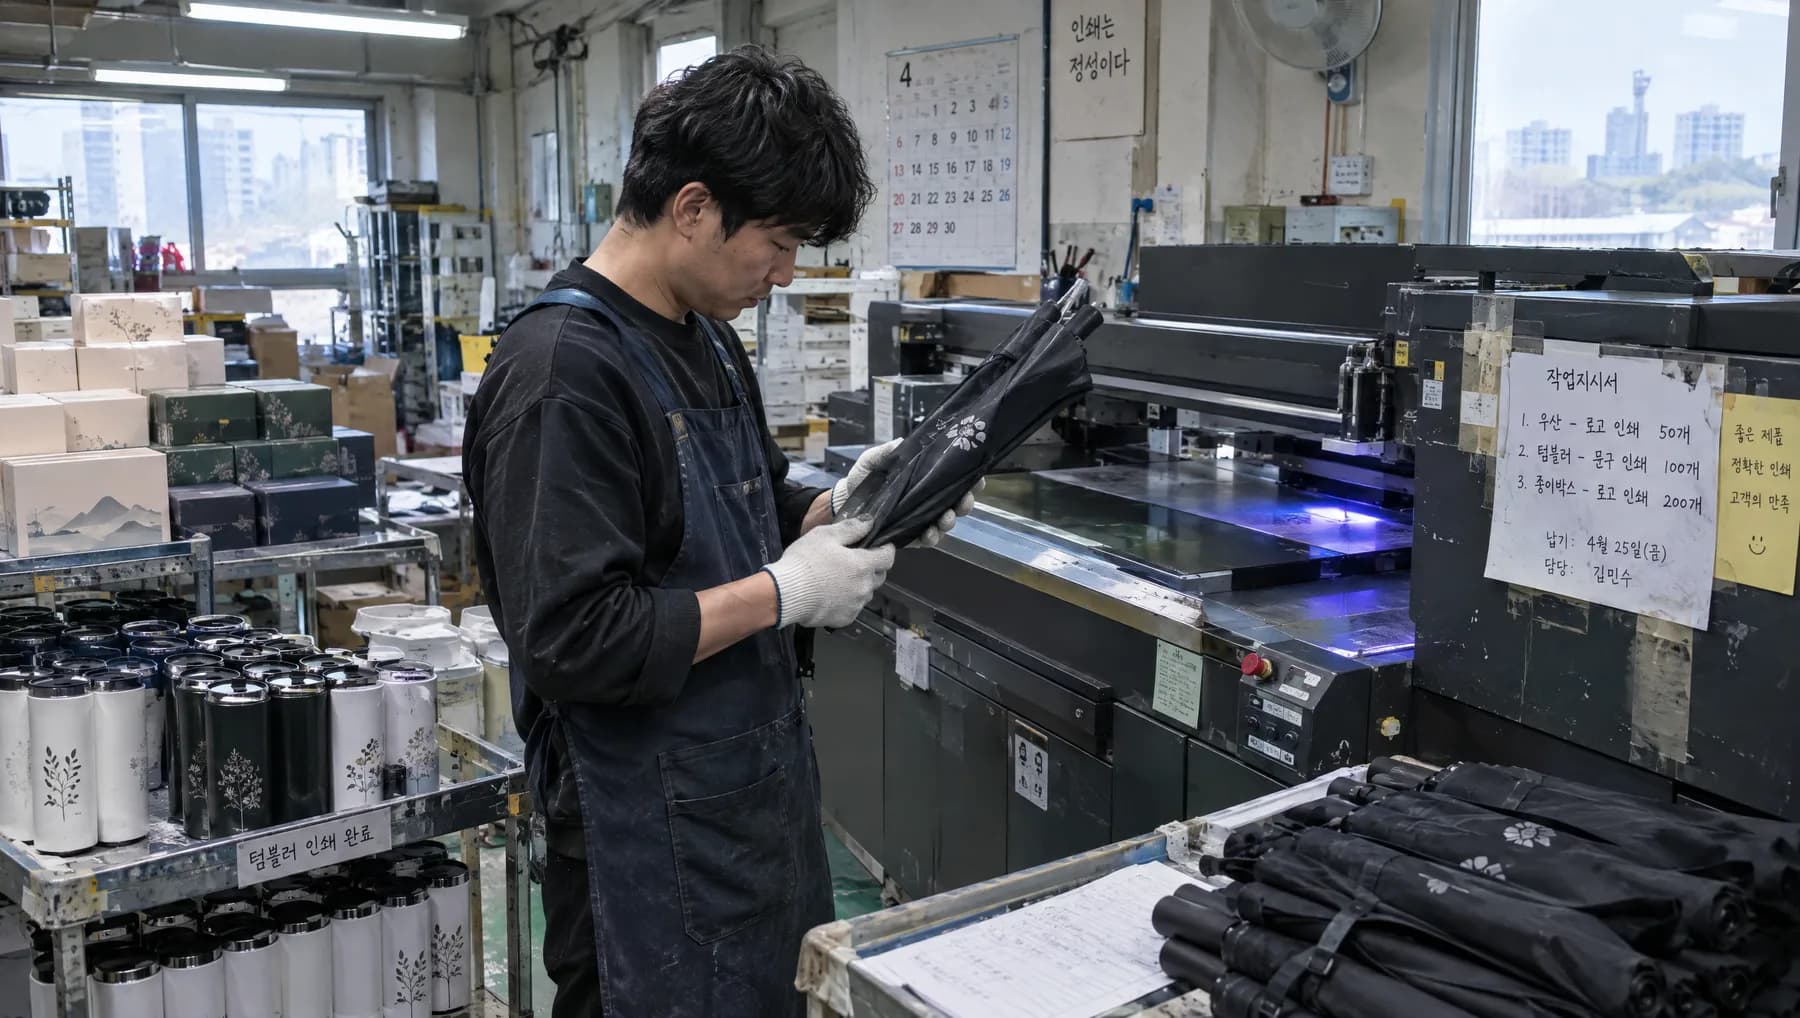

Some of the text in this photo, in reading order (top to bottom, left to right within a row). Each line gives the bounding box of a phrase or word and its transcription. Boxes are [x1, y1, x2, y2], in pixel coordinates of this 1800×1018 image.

[1072, 14, 1114, 42] 인쇄는
[900, 62, 912, 87] 4
[1070, 48, 1130, 82] 정성이다
[932, 104, 938, 117] 1
[950, 102, 958, 115] 2
[969, 99, 976, 113] 3
[1002, 96, 1010, 110] 5
[896, 127, 1012, 149] 6 7 8 9 10 11 12
[894, 158, 1012, 177] 13 14 15 16 17 18 19
[892, 189, 1011, 207] 20 21 22 23 24 25 26
[892, 222, 956, 235] 27 28 29 30
[1547, 368, 1617, 394] 작업지시서
[1522, 413, 1529, 427] 1.
[1539, 413, 1561, 431] 우산
[1586, 417, 1605, 433] 로고
[1615, 419, 1639, 438] 인쇄
[1660, 425, 1689, 445] 50개
[1734, 424, 1754, 443] 좋은
[1518, 445, 1528, 457] 2.
[1538, 445, 1570, 464] 텀블러
[1593, 450, 1614, 469] 문구
[1623, 453, 1646, 473] 인쇄
[1665, 461, 1699, 480] 100개
[1732, 457, 1790, 479] 정확한 인쇄
[1518, 475, 1527, 489] 3.
[1535, 475, 1576, 496] 종이박스
[1597, 485, 1616, 500] 로고
[1624, 488, 1647, 507] 인쇄
[1664, 495, 1701, 515] 200개
[1730, 491, 1789, 514] 고객의 만족
[1546, 531, 1575, 550] 납기:
[1587, 536, 1607, 554] 4월
[1545, 558, 1632, 588] 담당: 김민수
[306, 833, 336, 856] 인쇄
[344, 825, 374, 847] 완료
